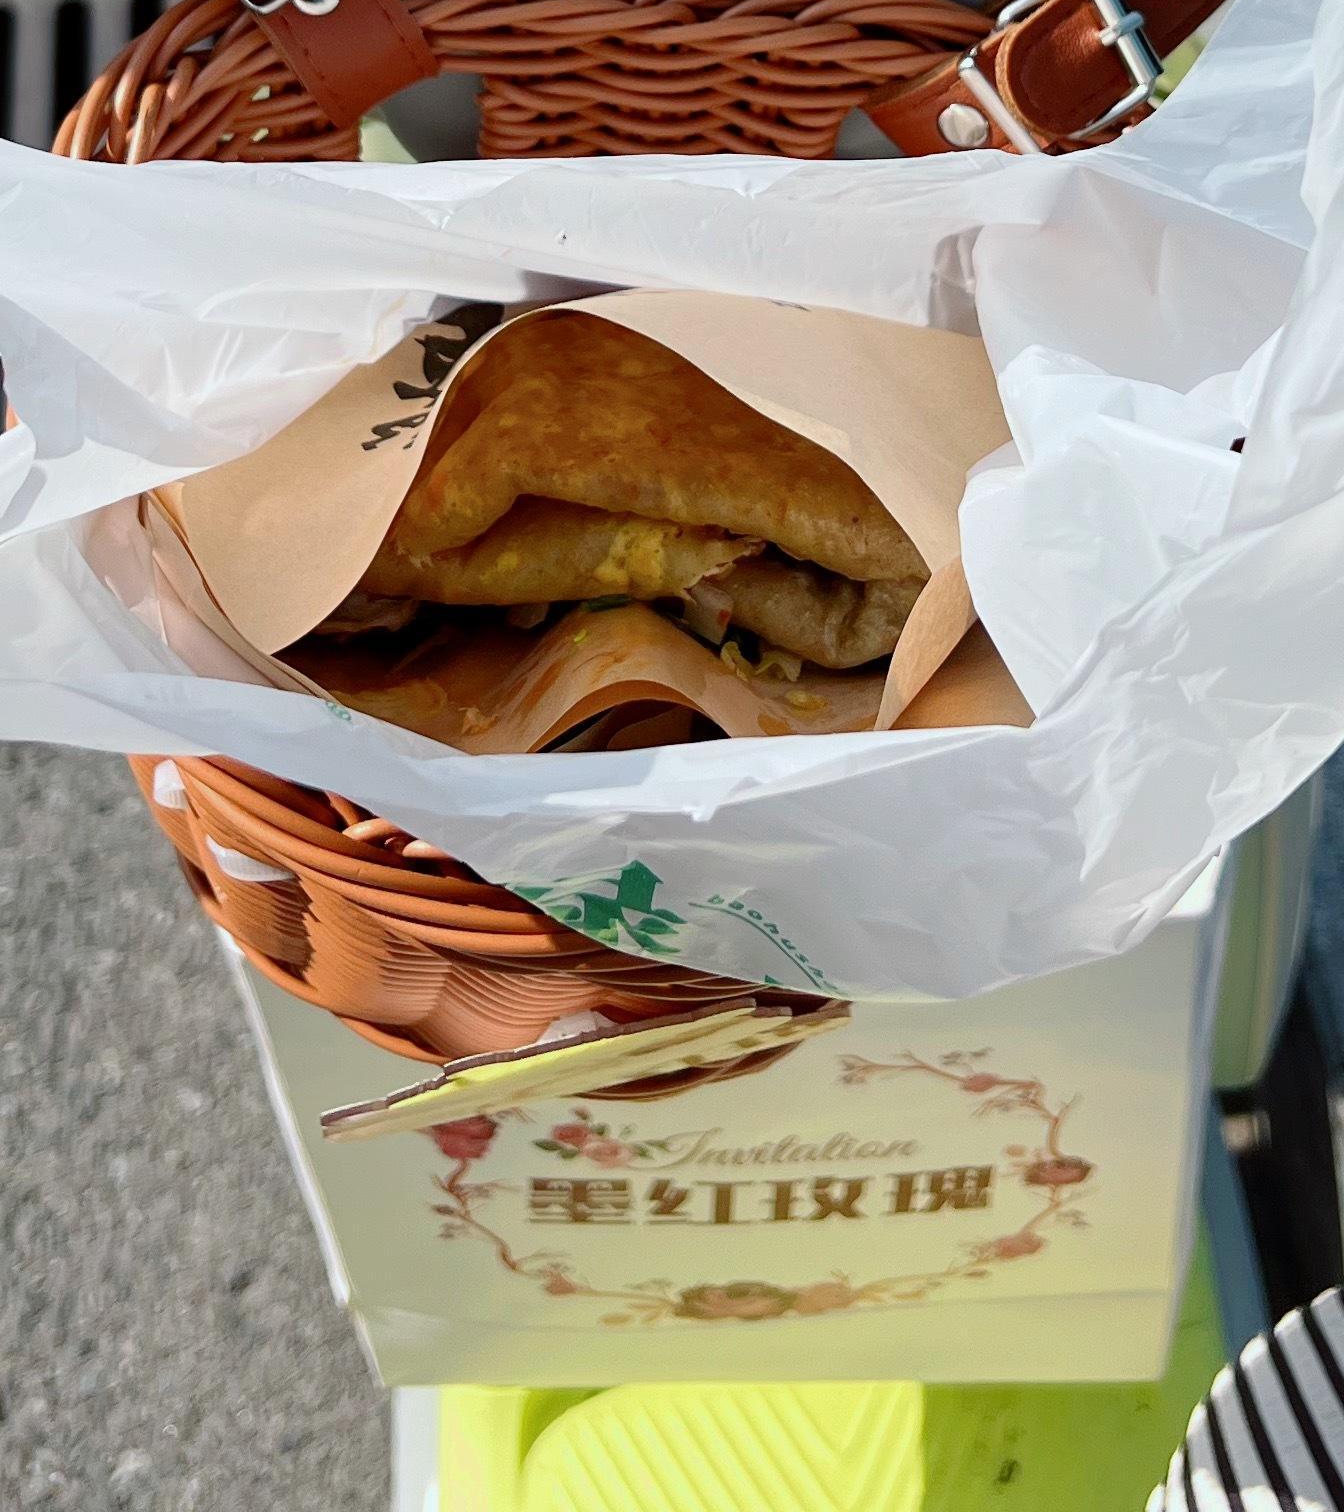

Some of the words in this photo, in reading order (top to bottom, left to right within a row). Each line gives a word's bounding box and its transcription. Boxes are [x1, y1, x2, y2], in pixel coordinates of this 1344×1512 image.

[629, 1126, 920, 1172] Invitation
[529, 1164, 995, 1226] 墨红玫瑰
